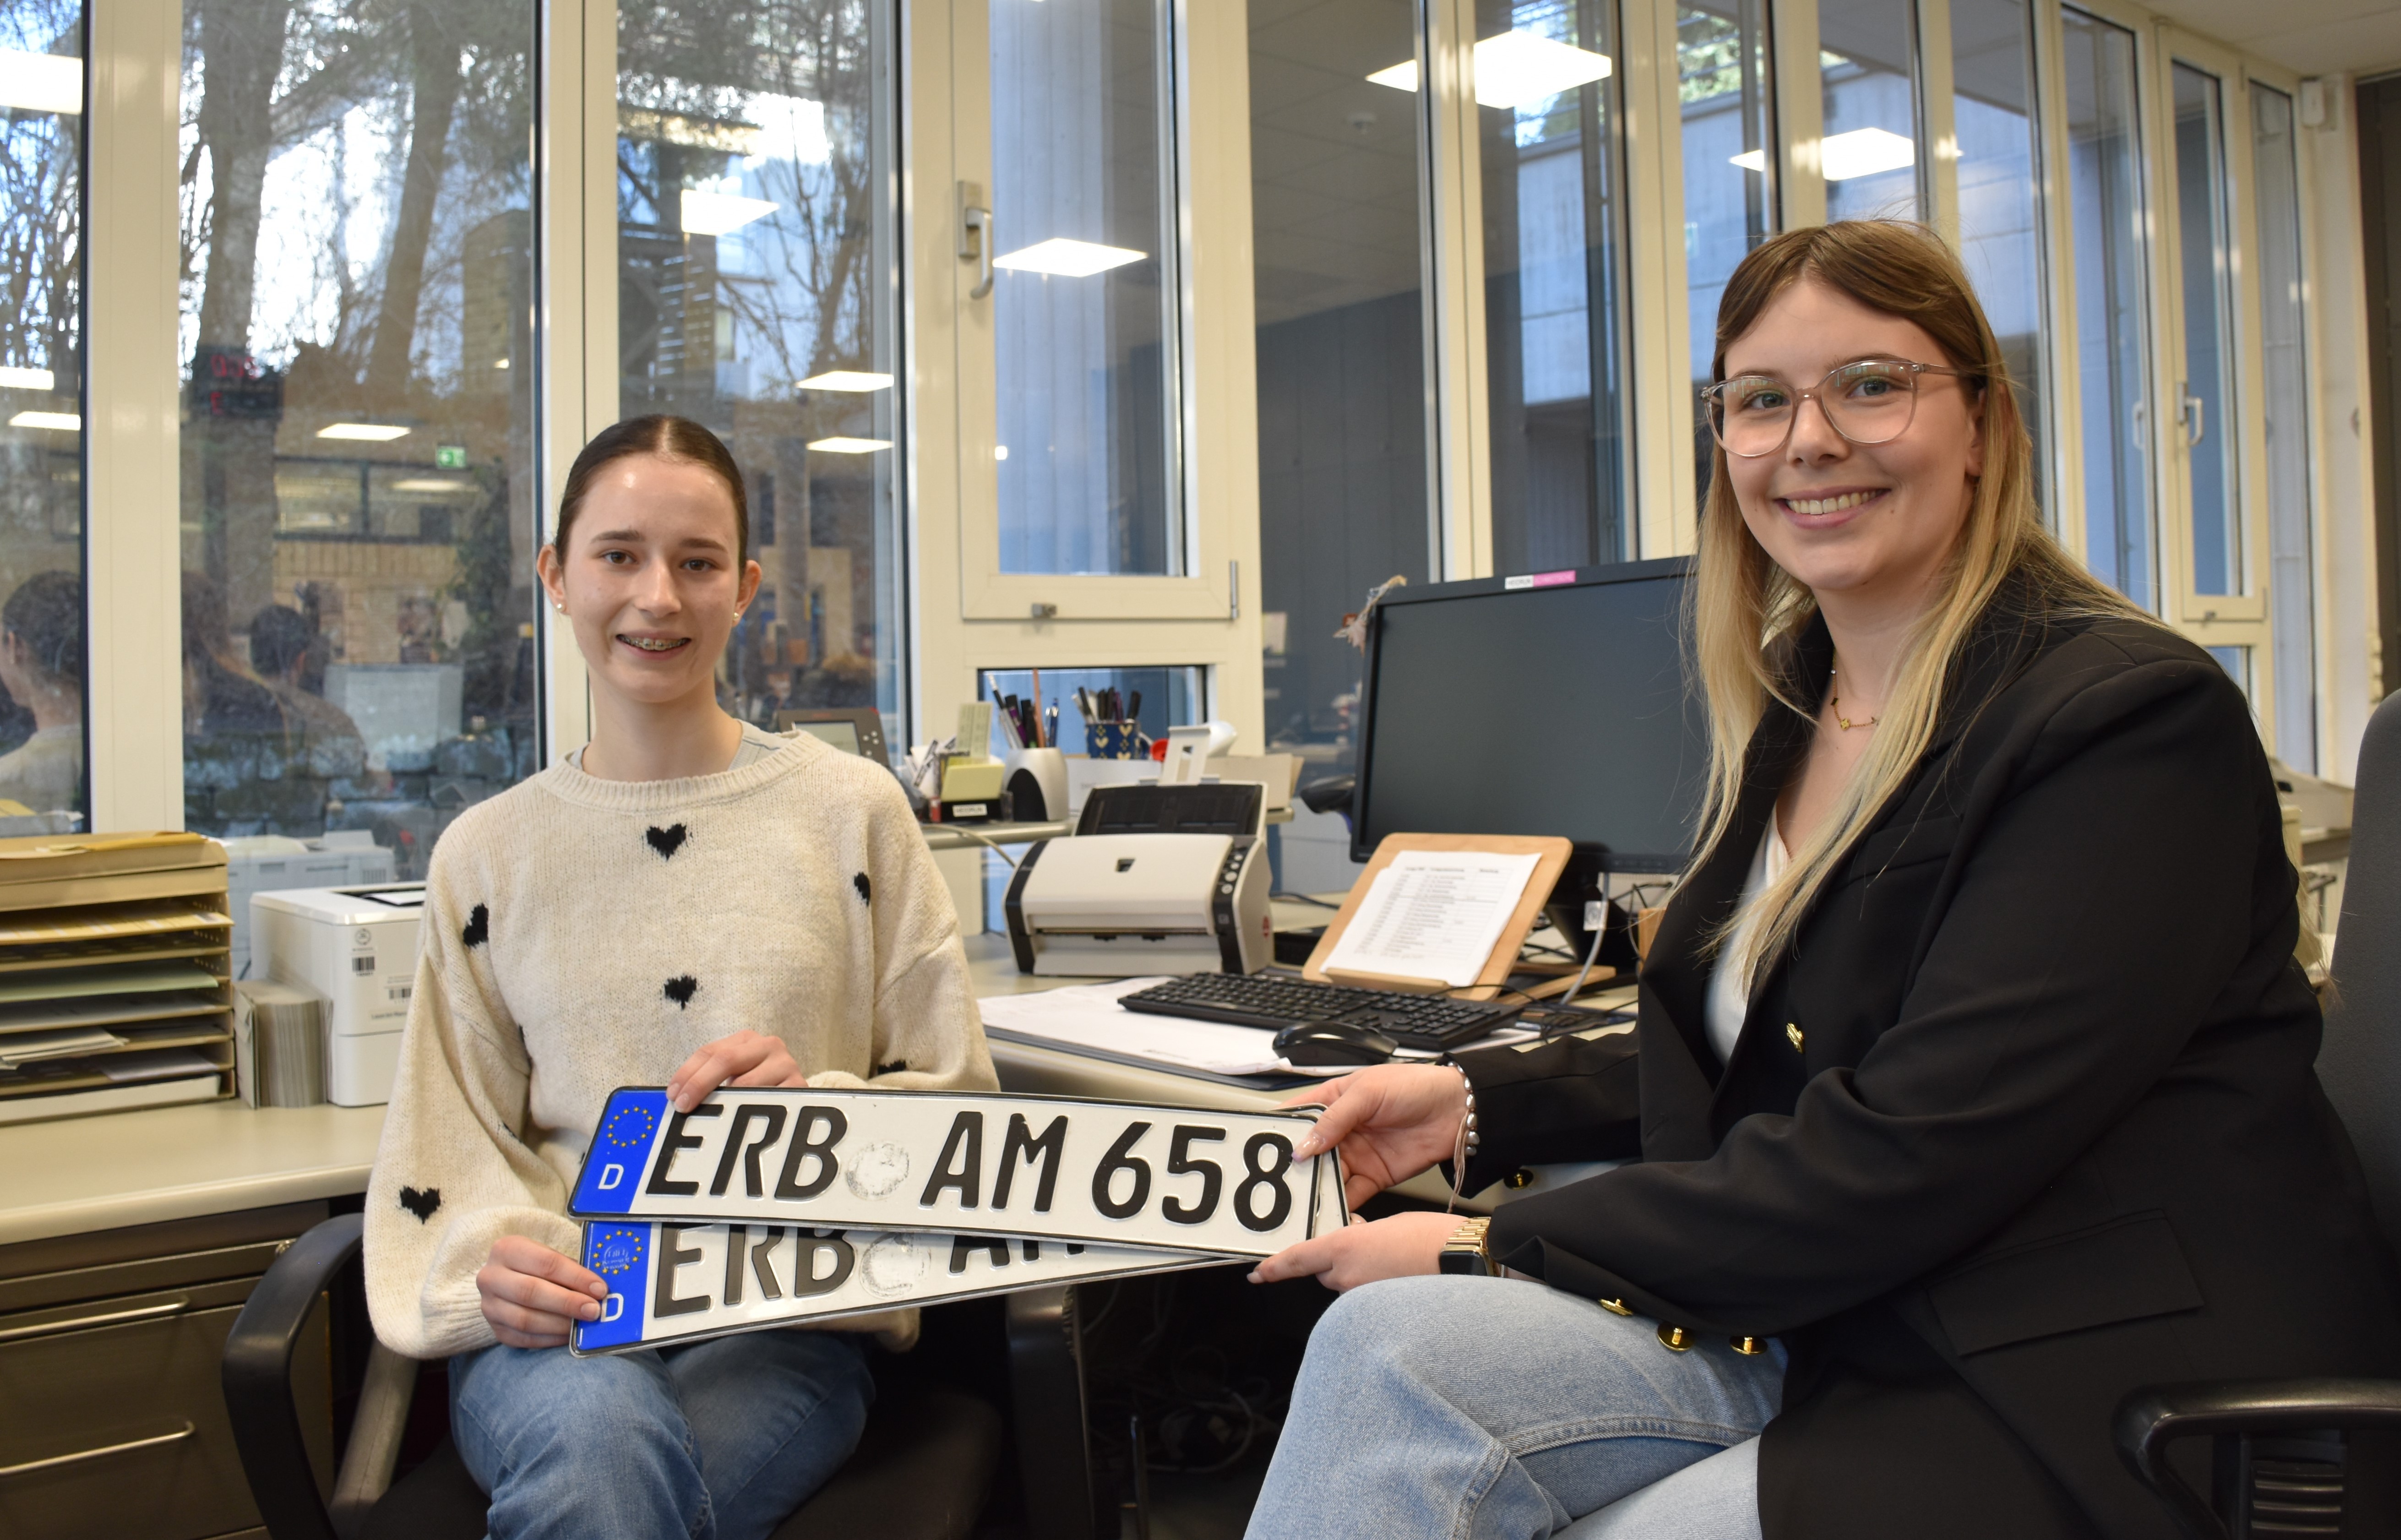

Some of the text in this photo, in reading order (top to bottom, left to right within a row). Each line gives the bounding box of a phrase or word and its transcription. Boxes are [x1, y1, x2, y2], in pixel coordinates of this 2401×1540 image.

[598, 1164, 624, 1189] D
[645, 1104, 1294, 1233] ERB AM 658
[654, 1223, 855, 1317] ERB
[600, 1293, 624, 1322] D
